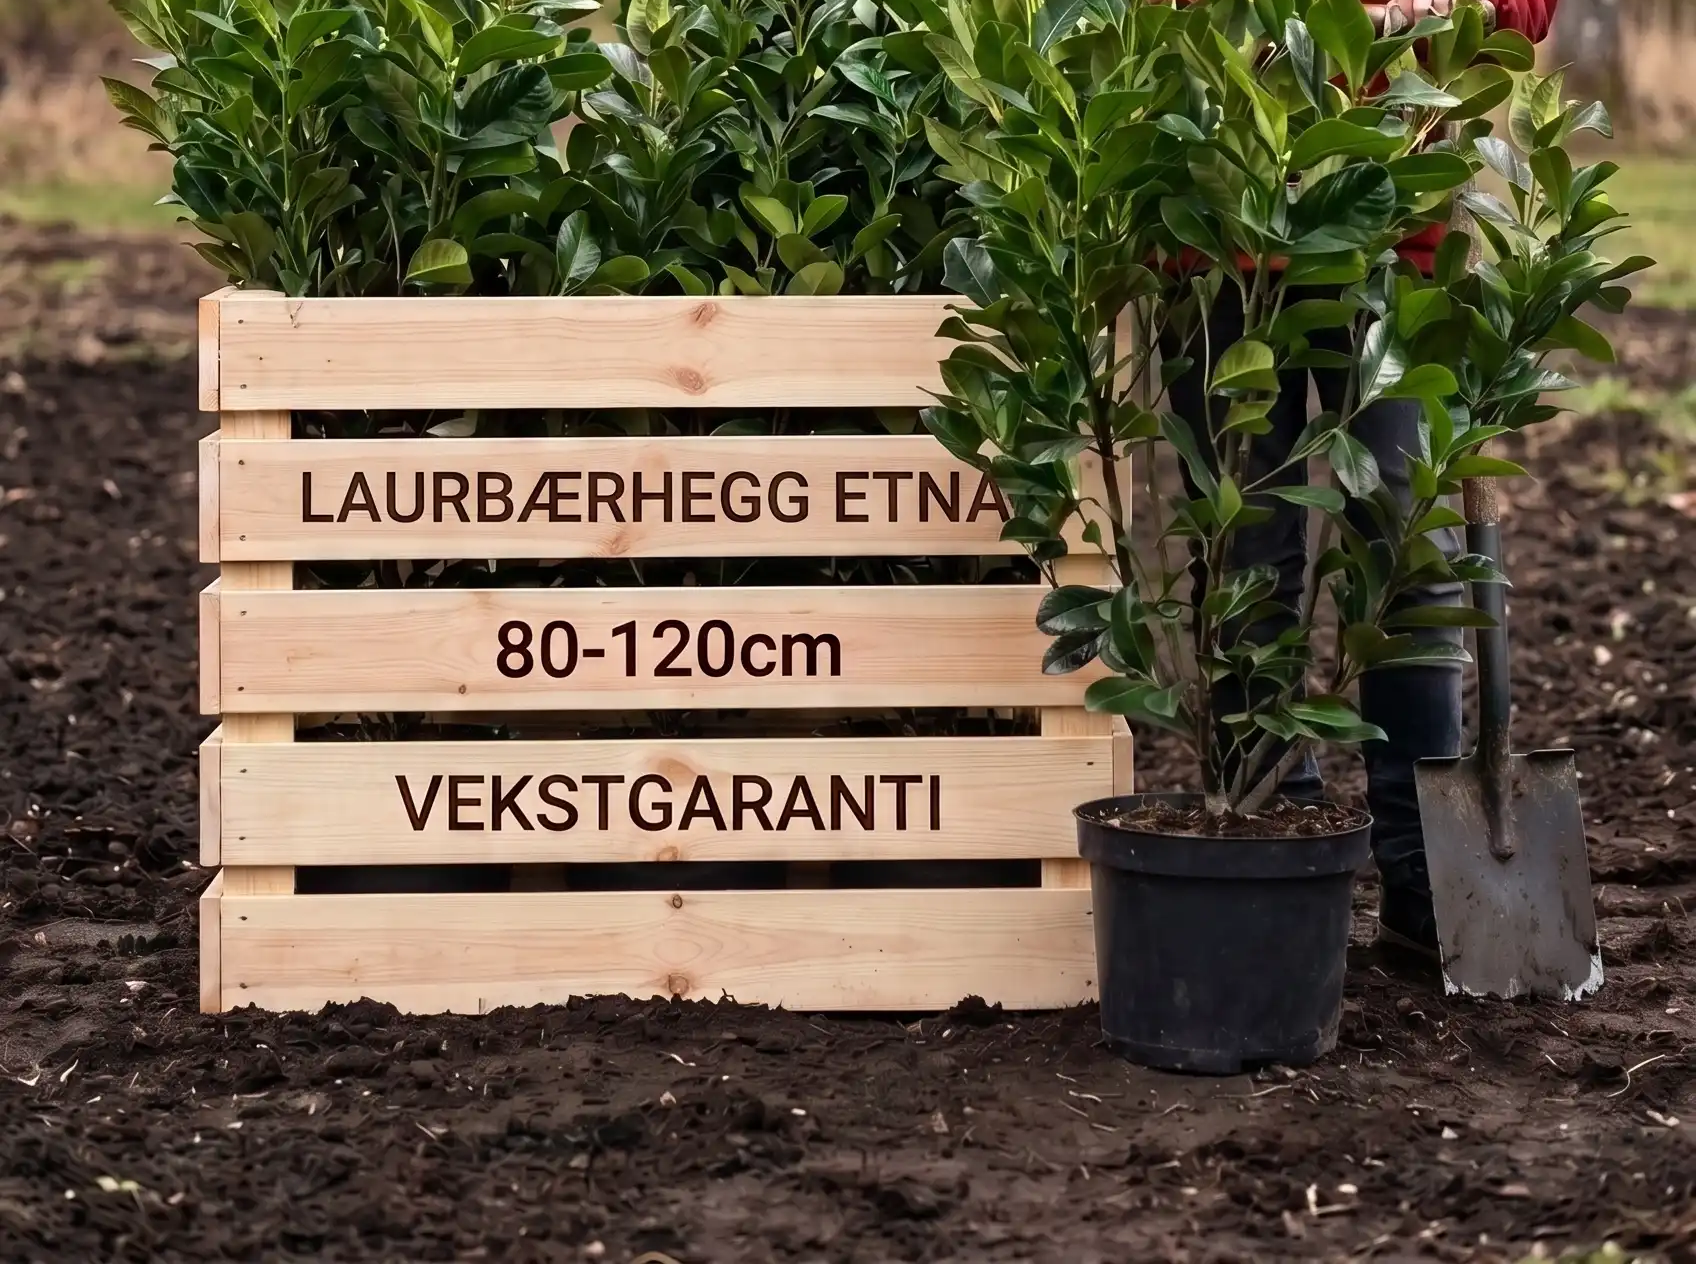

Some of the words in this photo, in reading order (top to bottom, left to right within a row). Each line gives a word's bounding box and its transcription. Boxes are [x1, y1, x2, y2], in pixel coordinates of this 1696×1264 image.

[301, 470, 809, 523] LAURBÆRHEGG
[835, 470, 1011, 523] ETNA
[496, 619, 842, 680] 80-120cm
[395, 773, 941, 832] VEKSTGARANTI
